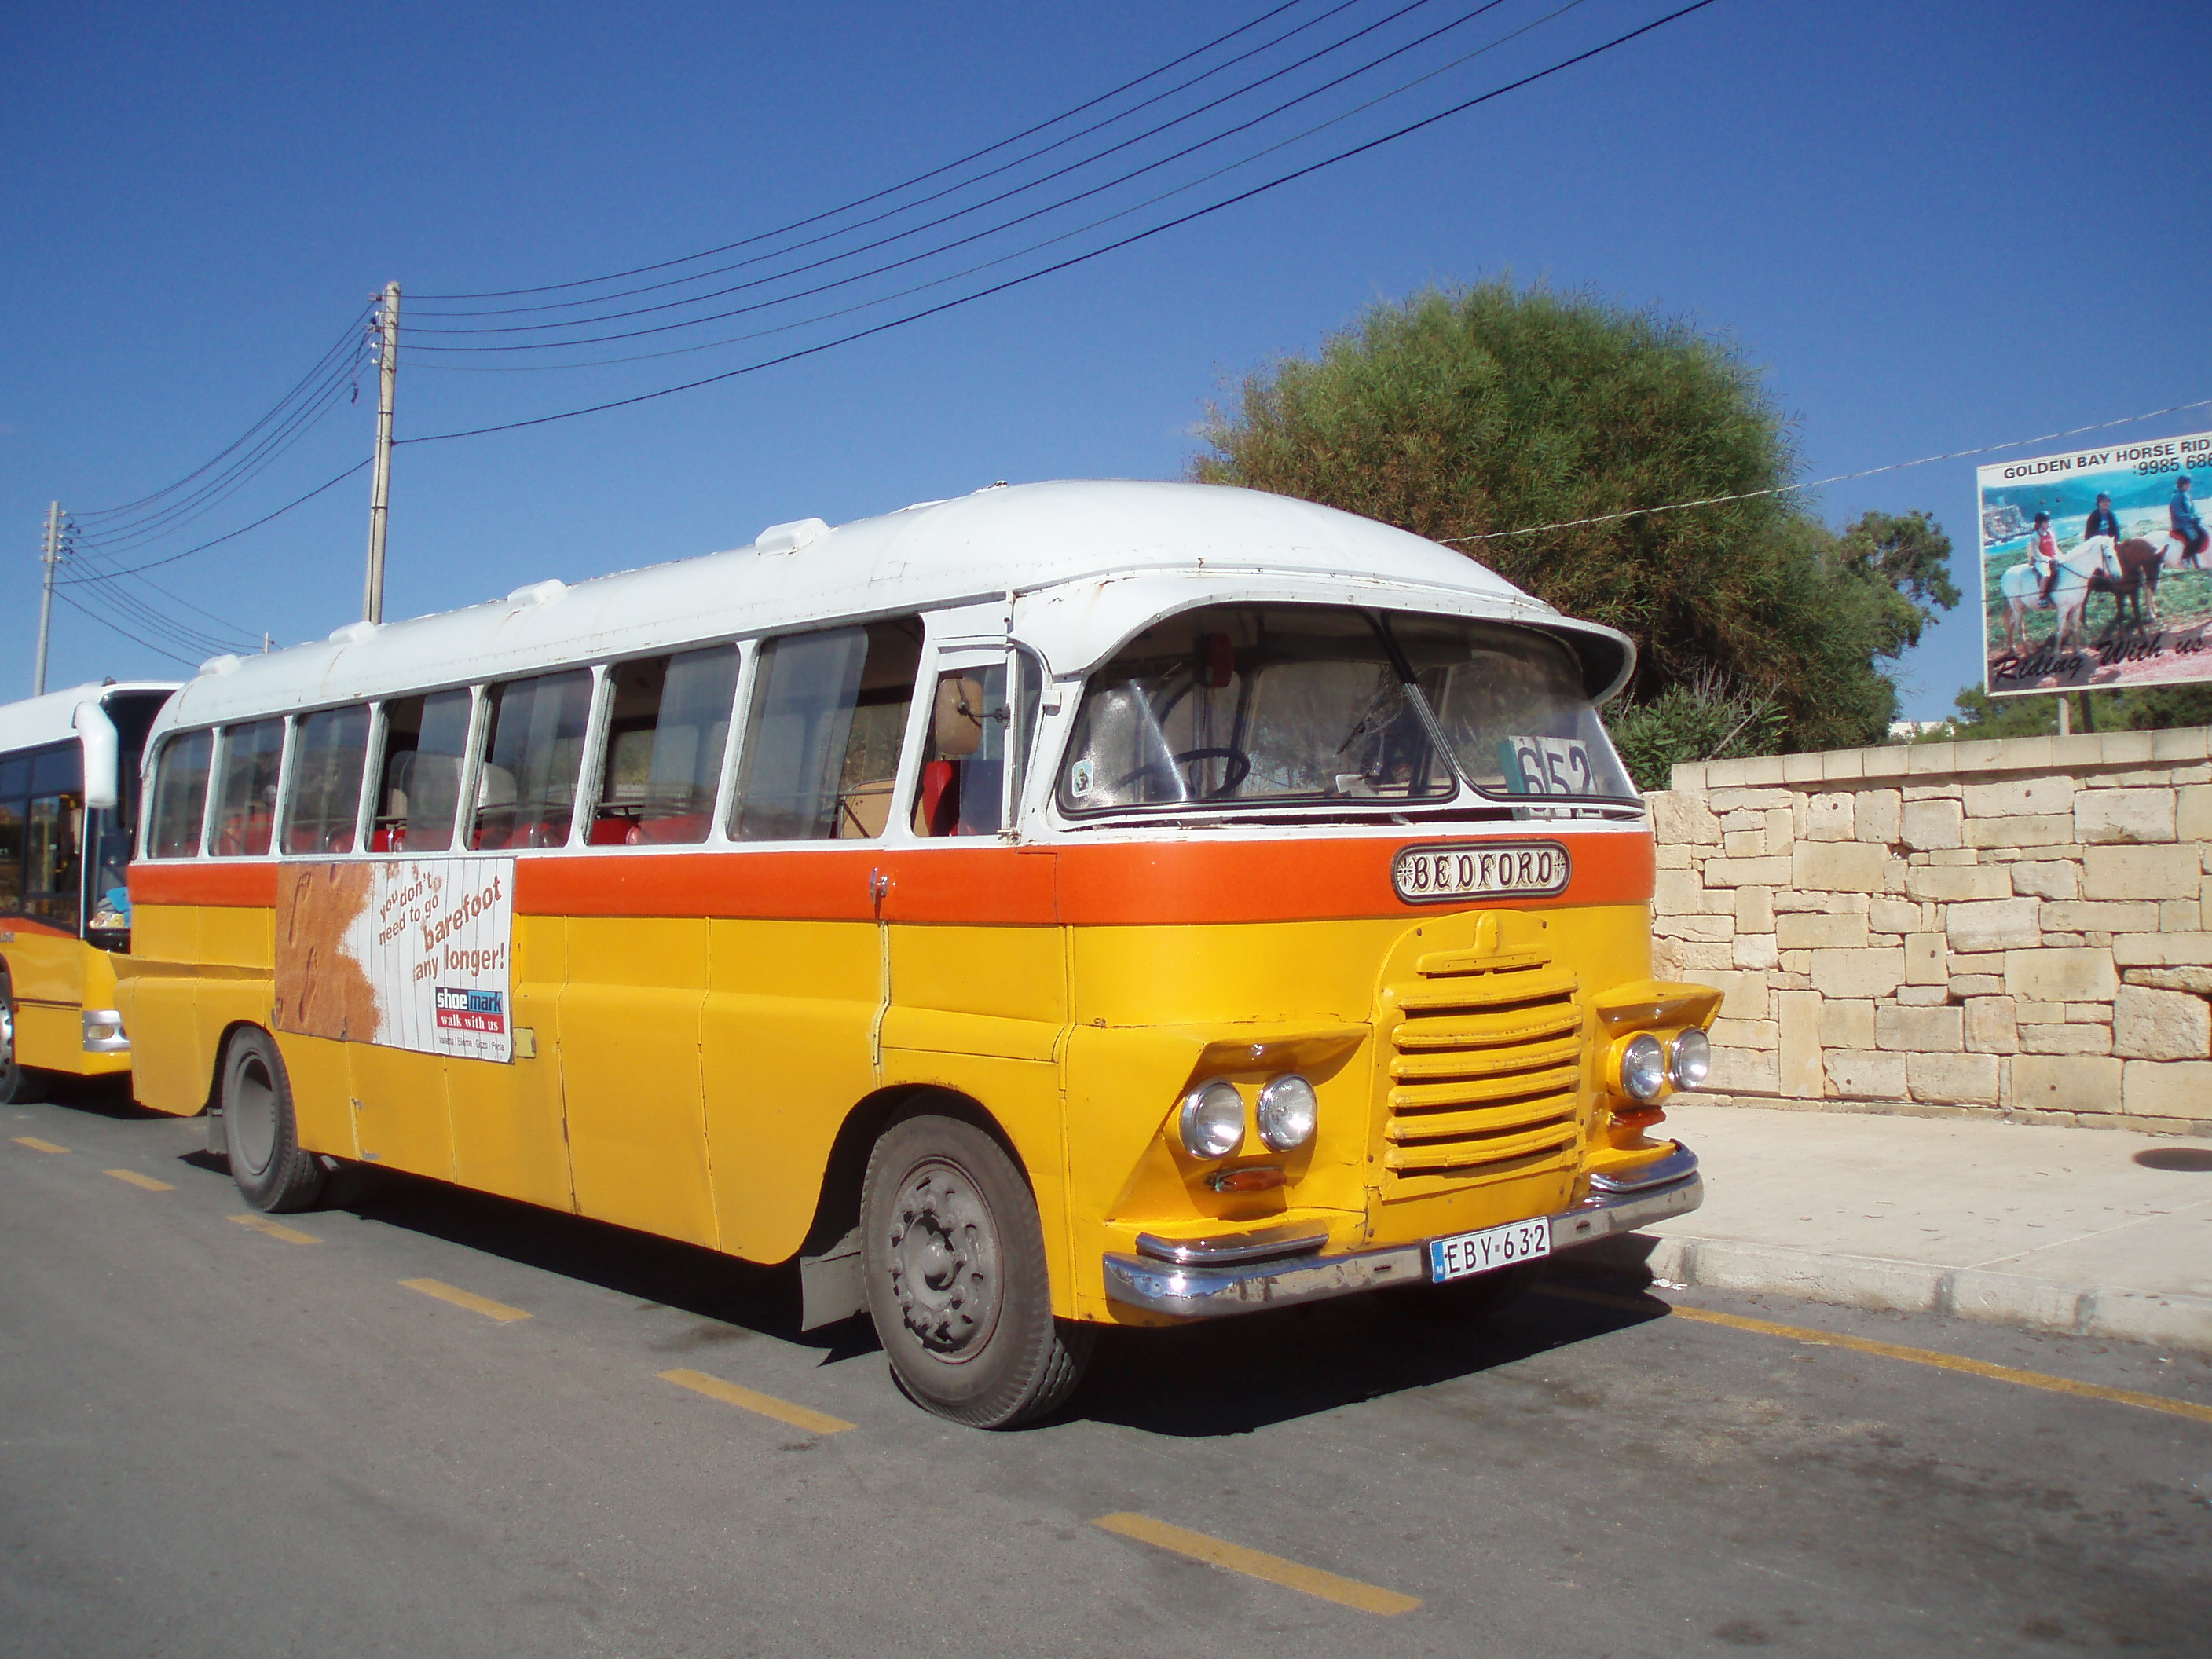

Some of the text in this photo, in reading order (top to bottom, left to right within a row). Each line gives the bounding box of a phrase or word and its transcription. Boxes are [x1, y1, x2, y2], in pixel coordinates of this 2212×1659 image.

[2004, 439, 2210, 479] GOLDEN BAY HORSE RID
[1994, 631, 2204, 684] Riding With us
[1518, 745, 1601, 814] 652
[1411, 850, 1553, 891] BEDFORD
[379, 895, 439, 946] need to go
[380, 871, 432, 923] you don't
[422, 875, 503, 954] barefoot
[416, 942, 504, 980] any longer!
[441, 1013, 499, 1031] walk with us
